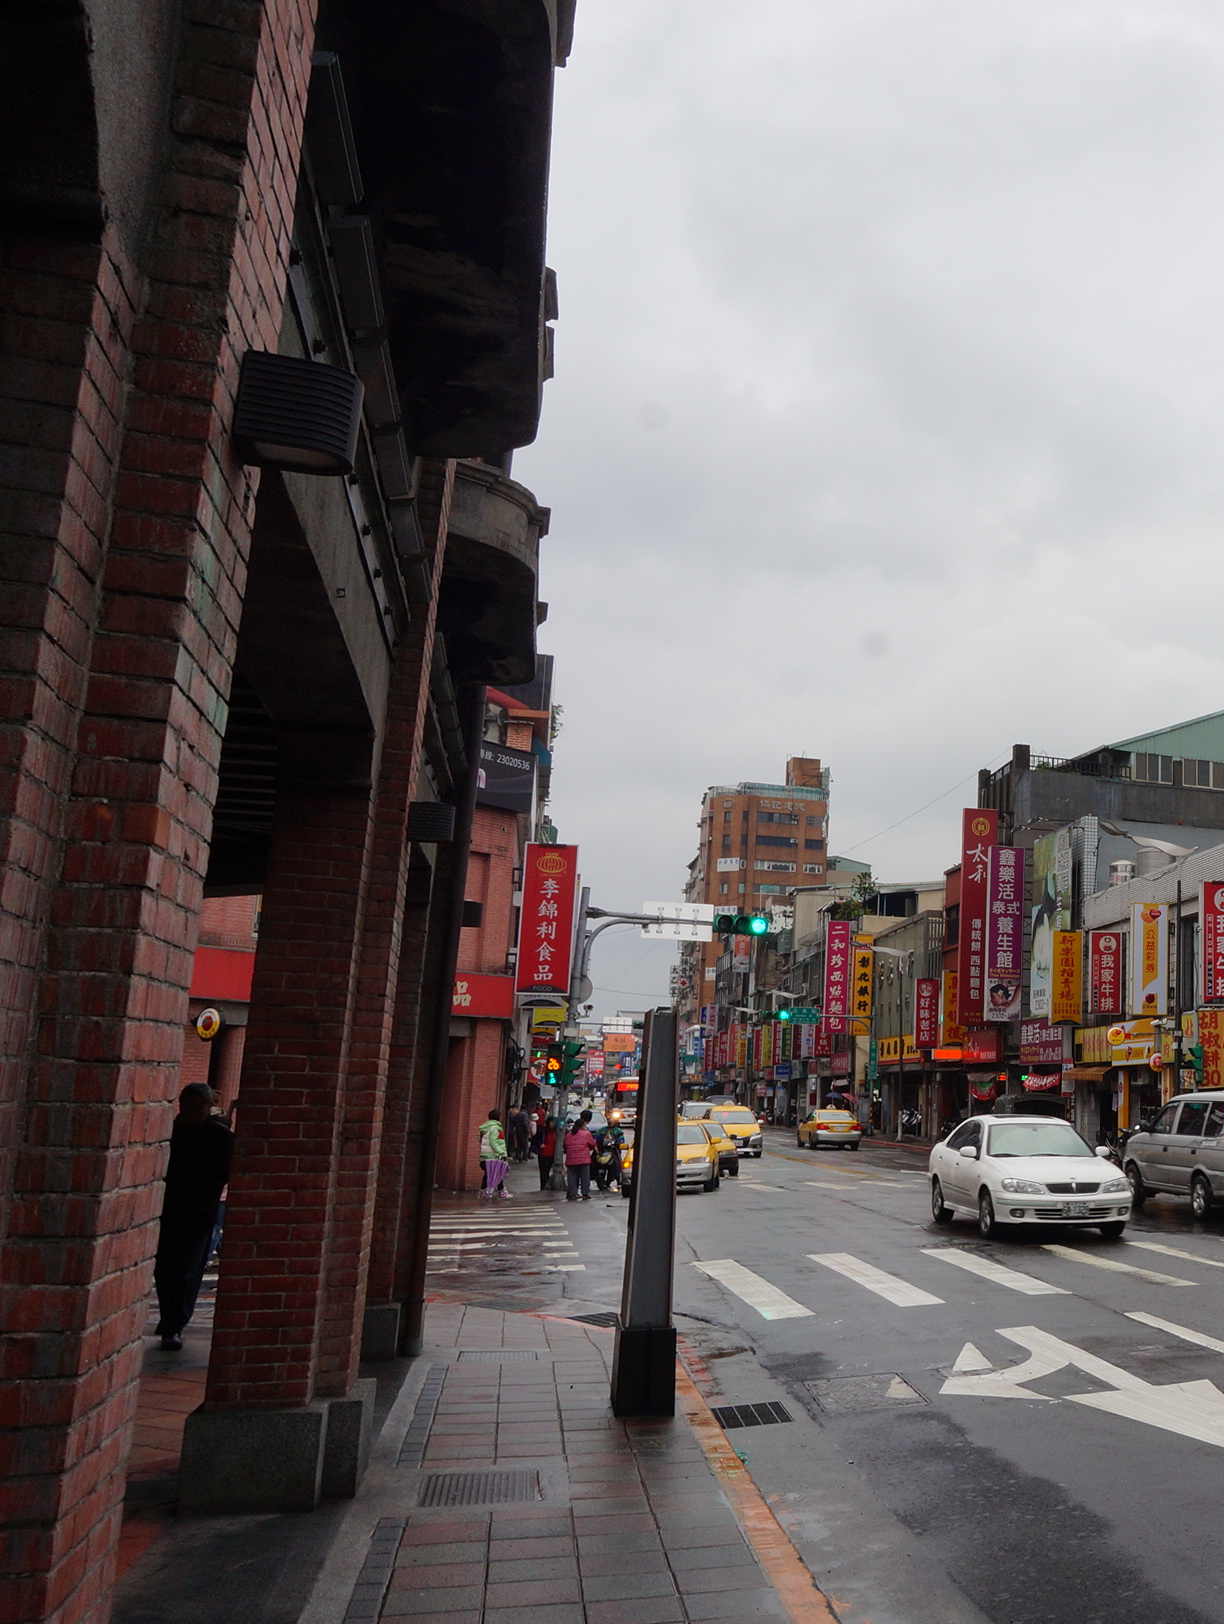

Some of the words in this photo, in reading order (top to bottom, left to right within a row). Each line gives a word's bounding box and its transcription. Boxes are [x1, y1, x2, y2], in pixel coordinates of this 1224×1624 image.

[497, 753, 530, 771] 23020536
[533, 879, 560, 981] 李錦利食品
[1145, 929, 1155, 973] 公益彩券
[857, 956, 869, 1012] 彰化銀行
[1100, 954, 1114, 1011] 我家牛排
[920, 998, 930, 1041] 好味老店
